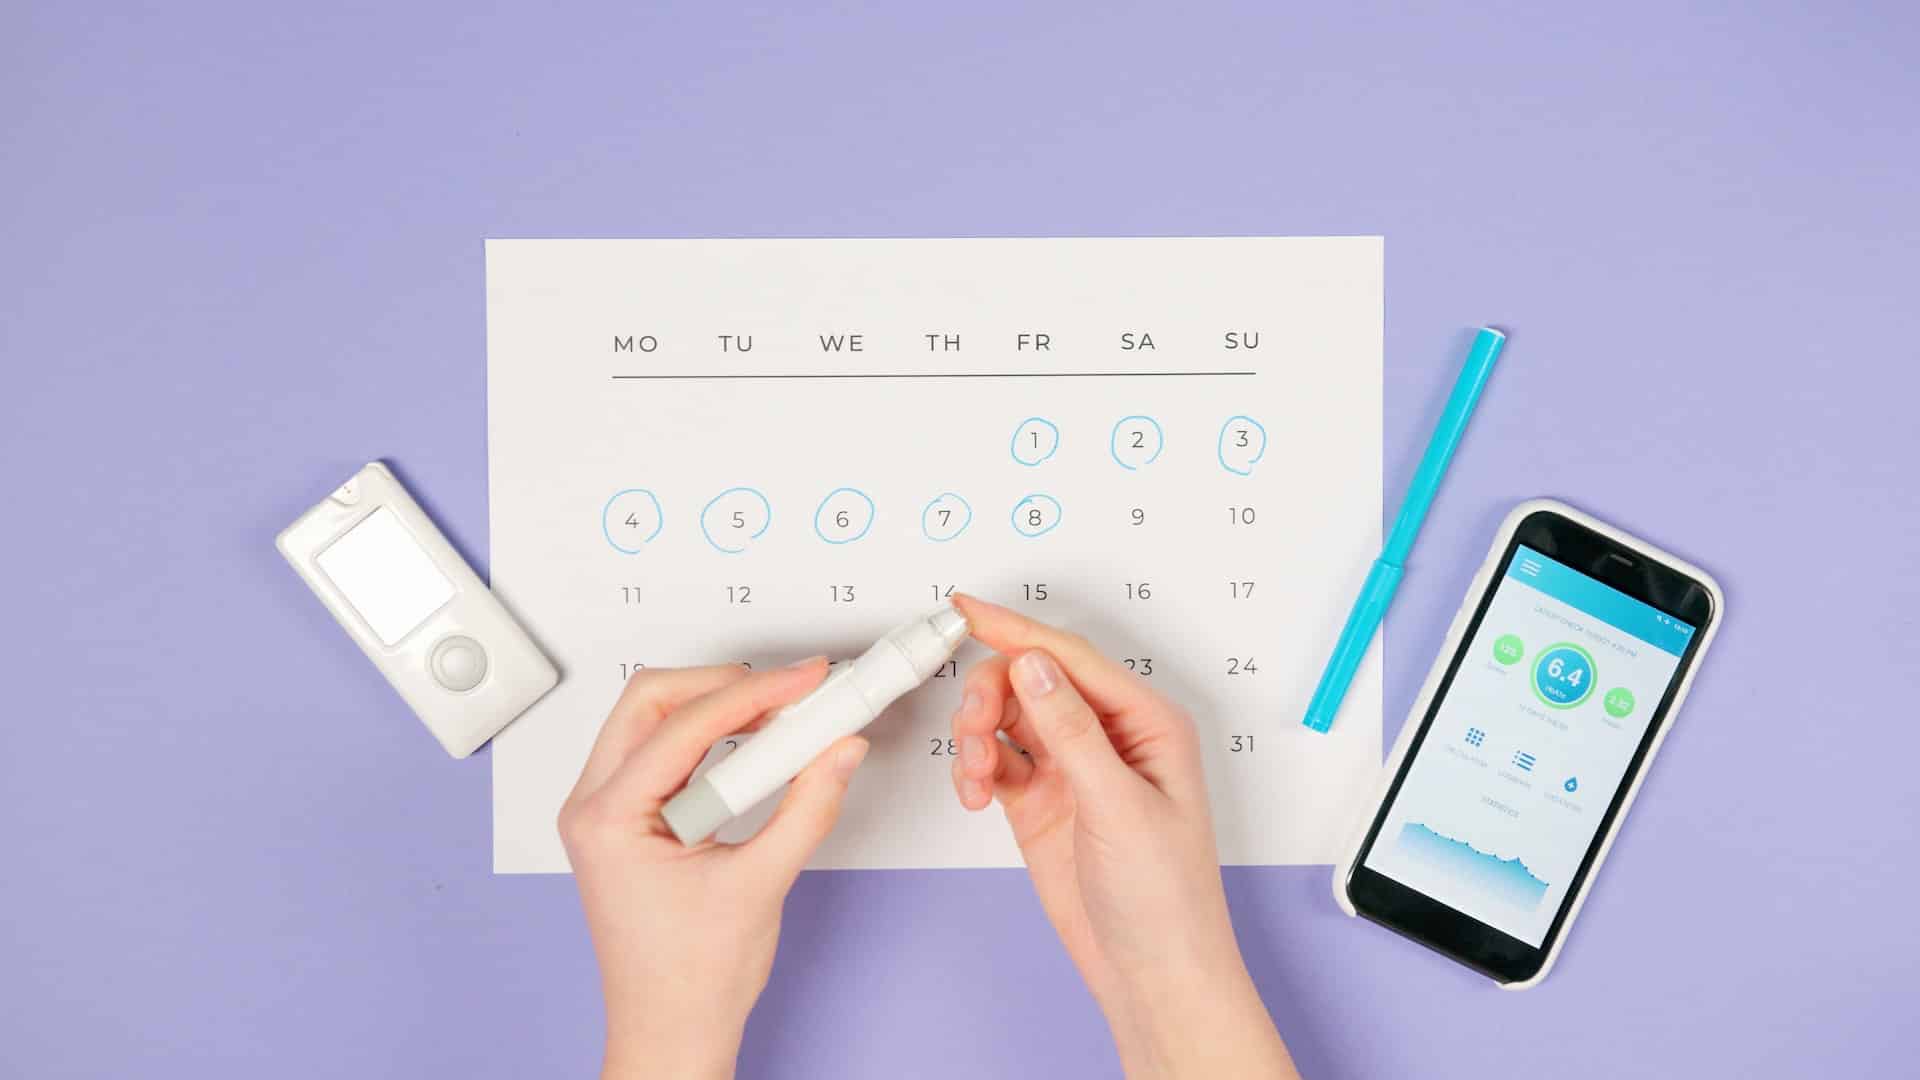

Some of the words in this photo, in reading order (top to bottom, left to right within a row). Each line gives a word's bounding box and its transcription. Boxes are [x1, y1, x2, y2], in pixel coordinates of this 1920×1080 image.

[614, 335, 658, 353] MO
[717, 335, 753, 353] TU
[819, 334, 864, 353] WE
[924, 333, 961, 353] TH
[1017, 333, 1051, 352] FR
[1120, 332, 1156, 351] SA
[1224, 331, 1259, 350] SU
[1131, 431, 1145, 449] 2
[1235, 430, 1249, 448] 3
[624, 512, 640, 529] 4
[732, 511, 745, 529] 5
[835, 510, 849, 528] 6
[937, 509, 952, 528] 7
[1028, 508, 1042, 527] 8
[1131, 508, 1145, 526] 9
[1228, 507, 1256, 525] 10
[621, 586, 641, 604] 11
[727, 585, 752, 604] 12
[830, 585, 855, 603] 13
[1023, 583, 1048, 601] 15
[1124, 582, 1152, 600] 16
[1229, 581, 1255, 599] 17
[932, 659, 957, 679] 21
[1226, 657, 1258, 676] 24
[1548, 657, 1583, 687] 6.4
[1230, 735, 1254, 753] 31
